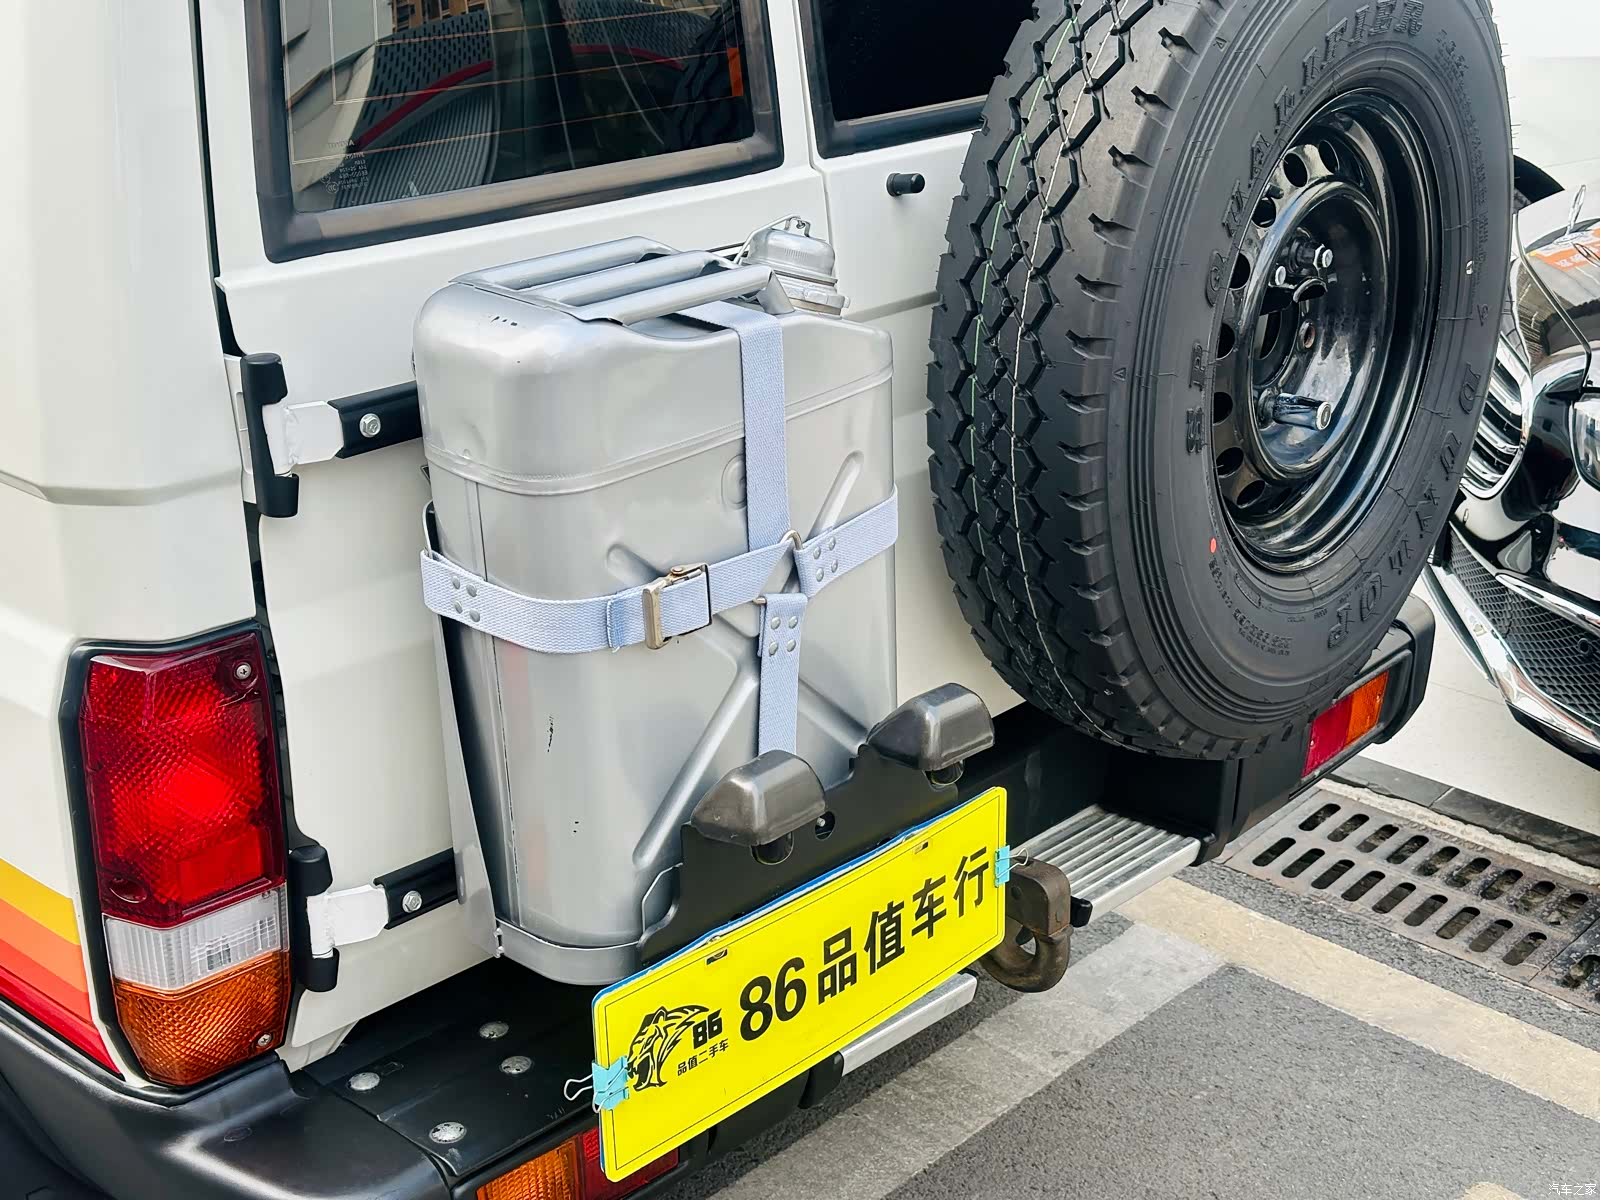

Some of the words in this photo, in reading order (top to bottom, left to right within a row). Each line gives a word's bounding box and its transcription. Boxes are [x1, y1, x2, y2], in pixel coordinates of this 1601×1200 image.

[1327, 361, 1481, 649] DUNLOP
[692, 1009, 723, 1050] 86
[677, 1038, 729, 1077] 品值二手车
